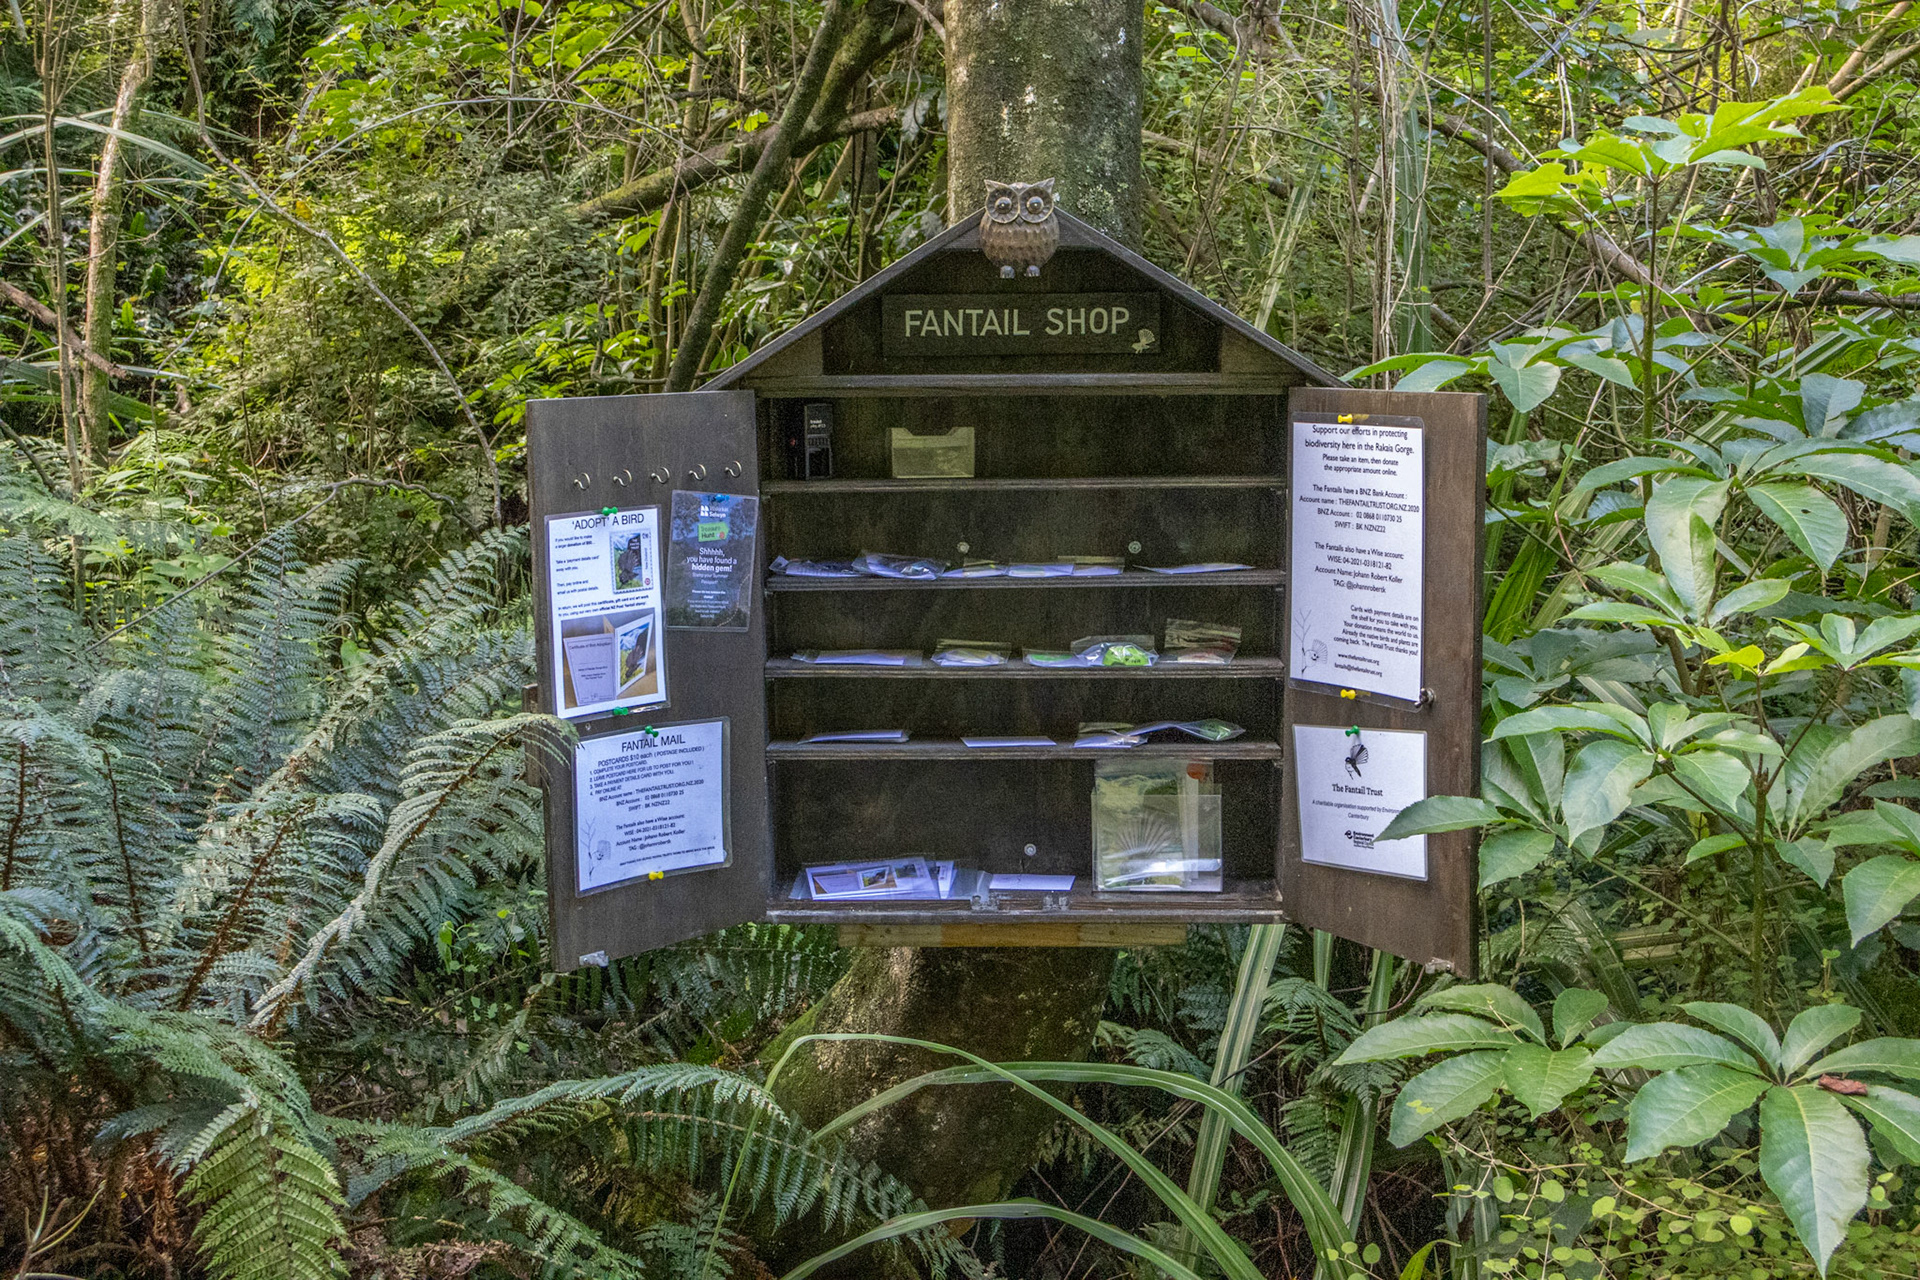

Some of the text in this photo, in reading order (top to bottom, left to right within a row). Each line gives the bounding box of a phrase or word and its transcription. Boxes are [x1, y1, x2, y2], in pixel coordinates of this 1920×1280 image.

[905, 307, 1130, 337] FANTAIL SHOP
[1312, 425, 1338, 436] Support
[1351, 427, 1371, 435] efforts
[1379, 428, 1408, 439] protecting
[1305, 439, 1341, 451] biodiversity
[1342, 441, 1356, 450] here
[1364, 442, 1374, 451] the
[1375, 443, 1394, 452] Rakaia
[1394, 444, 1414, 455] Gorge.
[1334, 464, 1362, 474] appropriate
[1324, 485, 1342, 493] Fantails
[1384, 490, 1405, 498] Account
[1299, 496, 1320, 504] Account
[1330, 509, 1350, 517] Account
[612, 516, 619, 526] A
[622, 514, 644, 524] BIRD
[1334, 521, 1351, 529] SWIFT
[1364, 523, 1386, 532] NZNZ22
[1325, 542, 1344, 551] Fantails
[1355, 546, 1367, 554] have
[1371, 548, 1383, 556] Wise
[715, 564, 732, 573] gem!
[1315, 565, 1336, 574] Account
[1353, 570, 1370, 579] Johann
[1371, 572, 1388, 581] Robert
[1388, 574, 1403, 583] Koller
[1374, 609, 1391, 618] payment
[1354, 623, 1372, 631] donation
[1334, 636, 1349, 646] coming
[1342, 629, 1358, 639] Already
[1398, 638, 1410, 647] plants
[622, 734, 686, 752] FANTAIL MAIL
[1332, 784, 1383, 796] The Fantail Trust
[1334, 801, 1357, 811] organisation
[1356, 804, 1377, 813] supported
[1348, 812, 1369, 821] Canterbury
